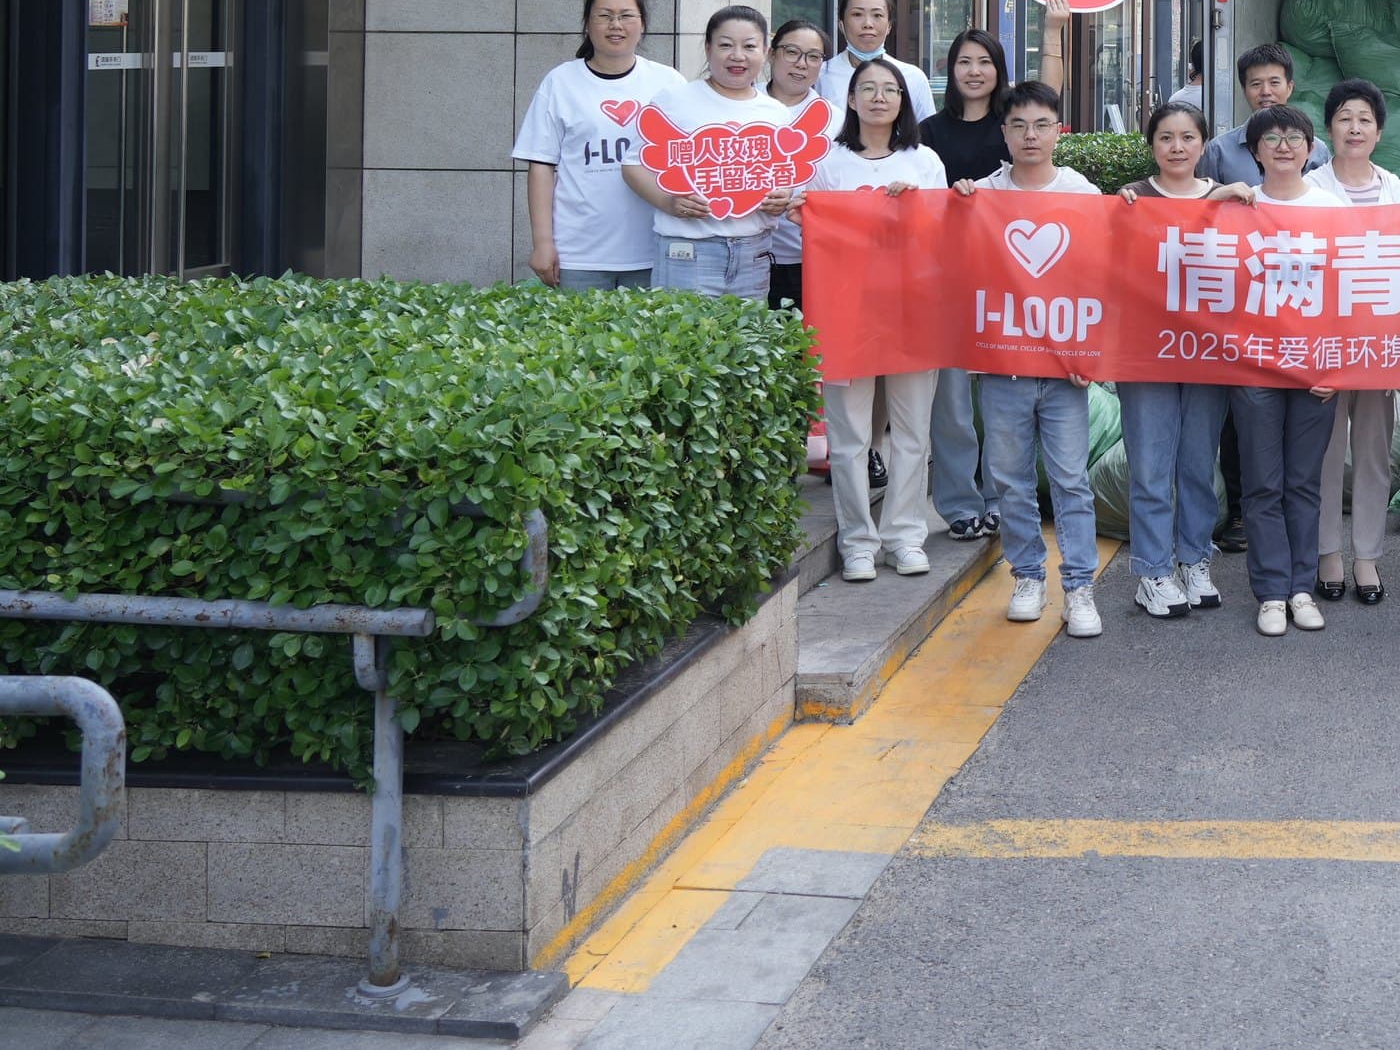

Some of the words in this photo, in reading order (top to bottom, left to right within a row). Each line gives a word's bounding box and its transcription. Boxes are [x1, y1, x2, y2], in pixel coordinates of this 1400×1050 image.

[667, 134, 773, 166] 赠人玫瑰
[695, 162, 797, 193] 手留余香
[975, 289, 1103, 342] I-LOOP
